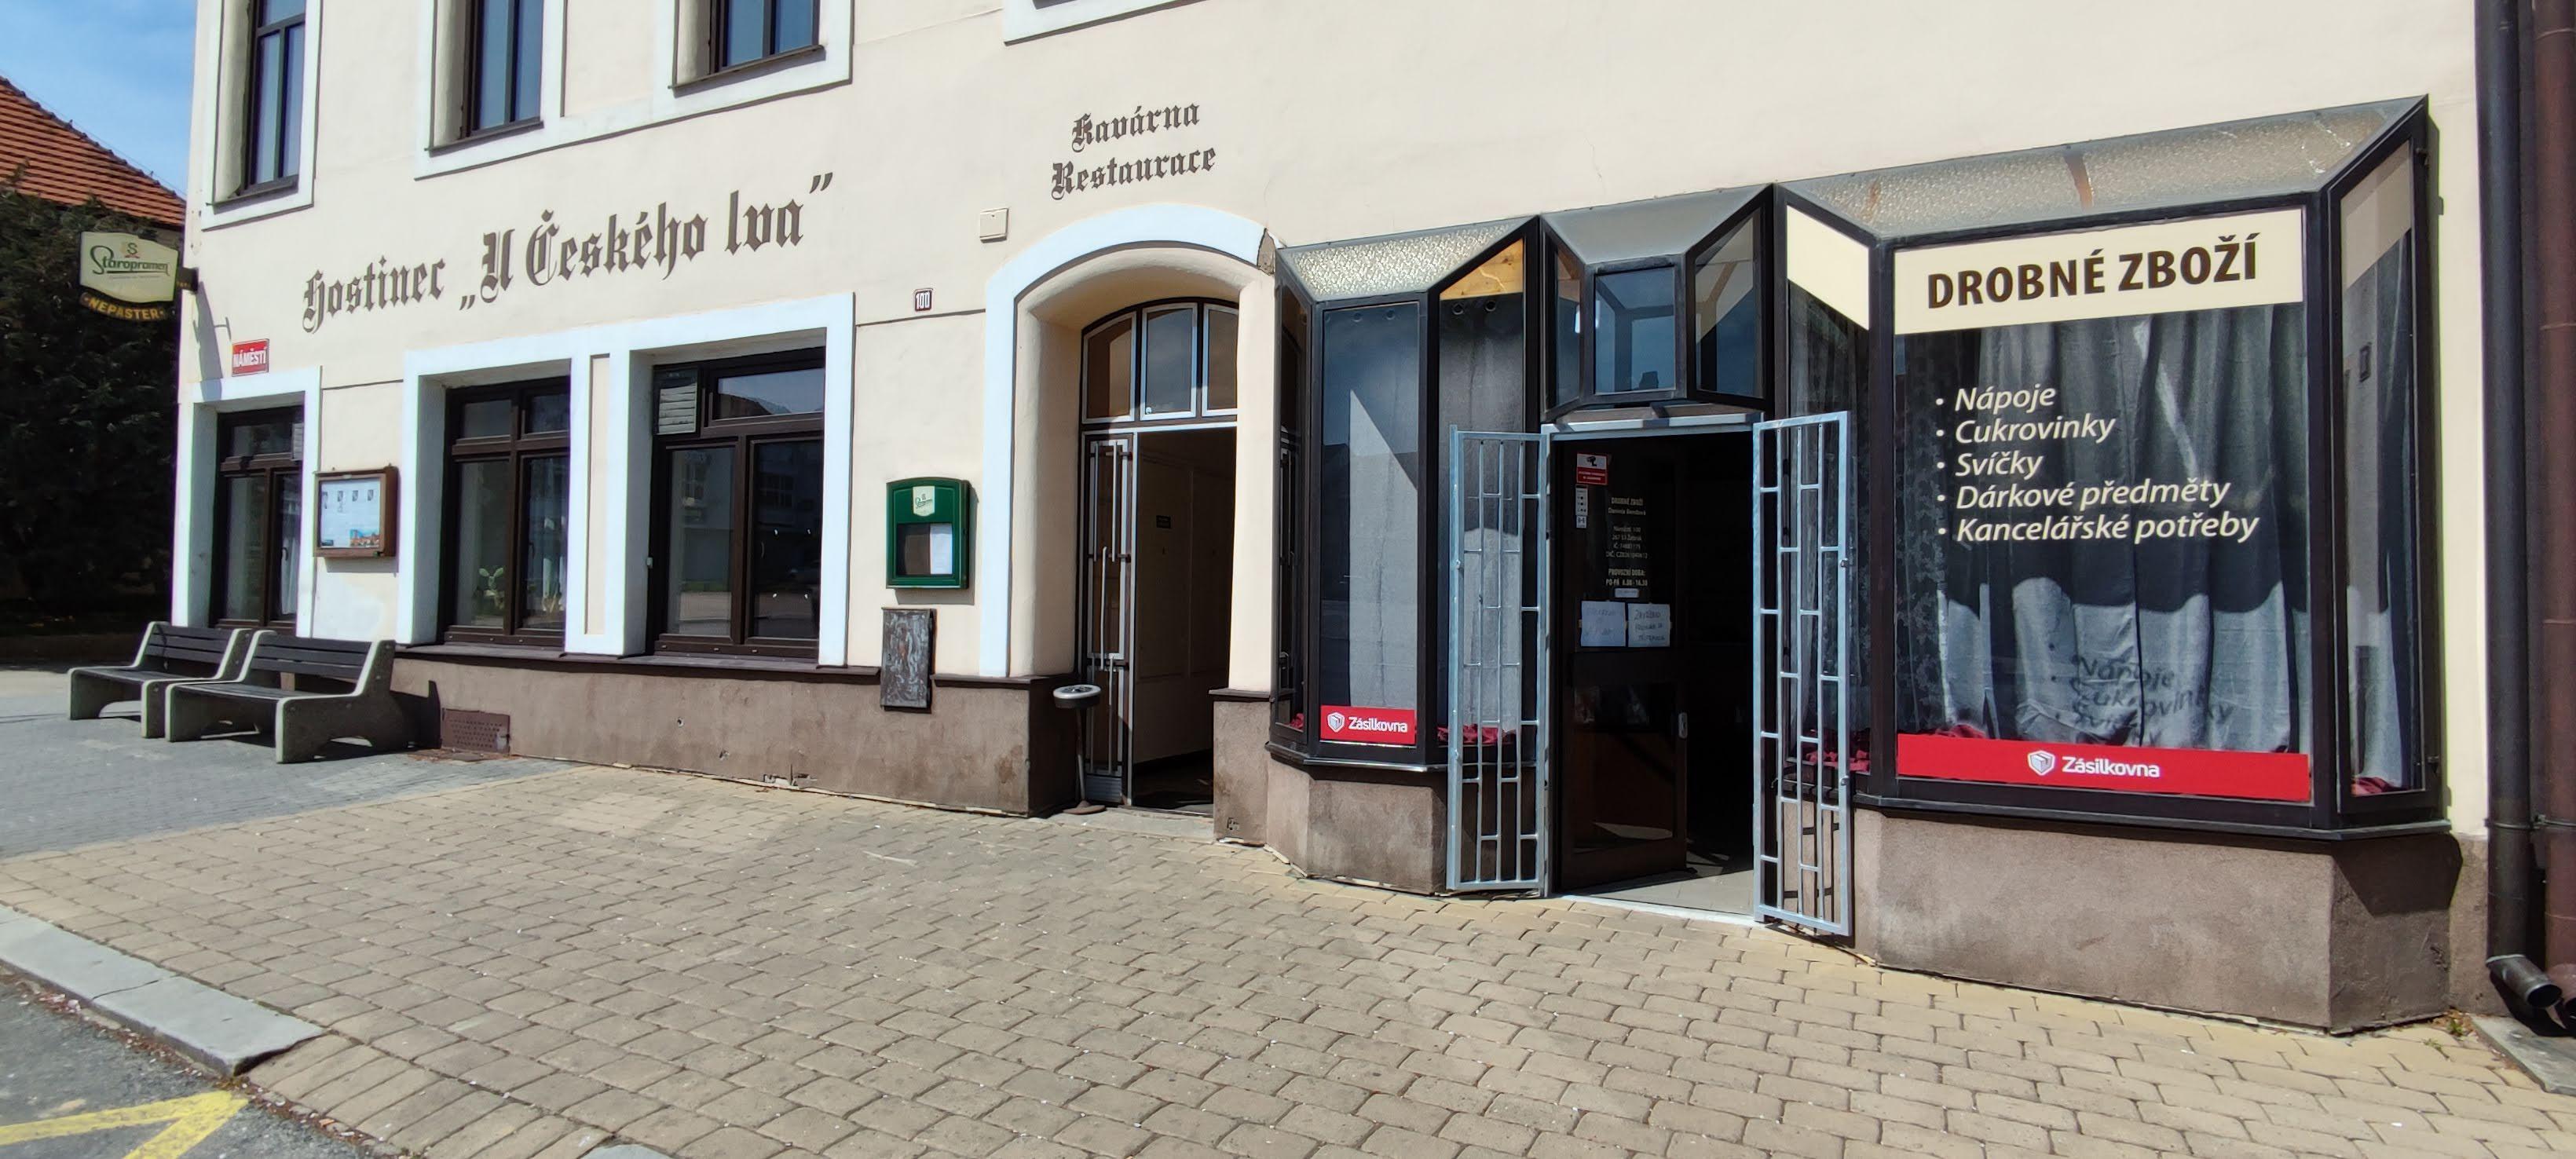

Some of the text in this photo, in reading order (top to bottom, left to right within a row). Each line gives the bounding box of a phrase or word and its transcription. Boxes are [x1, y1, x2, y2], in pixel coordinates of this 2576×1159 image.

[1071, 102, 1200, 153] Kavárna
[1051, 147, 1217, 201] Restaurace
[90, 245, 170, 276] Staropramen
[302, 255, 446, 335] Hostinec
[525, 210, 708, 286] Českého
[1927, 232, 2261, 309] DROBNÉ ZBOŽÍ
[88, 297, 159, 320] NEPASTER
[916, 291, 931, 309] 100
[233, 346, 267, 367] NÁMĚSTÍ
[1954, 383, 2056, 414] Nápoje
[1955, 413, 2116, 444] Cukrovinky
[1956, 450, 2044, 480] Svíčky
[1956, 477, 2231, 512] Dárkové předměty
[1956, 510, 2259, 544] Kancelářské potřeby
[1348, 716, 1408, 733] Zásilkovna
[2062, 755, 2161, 778] Zásilkovna
